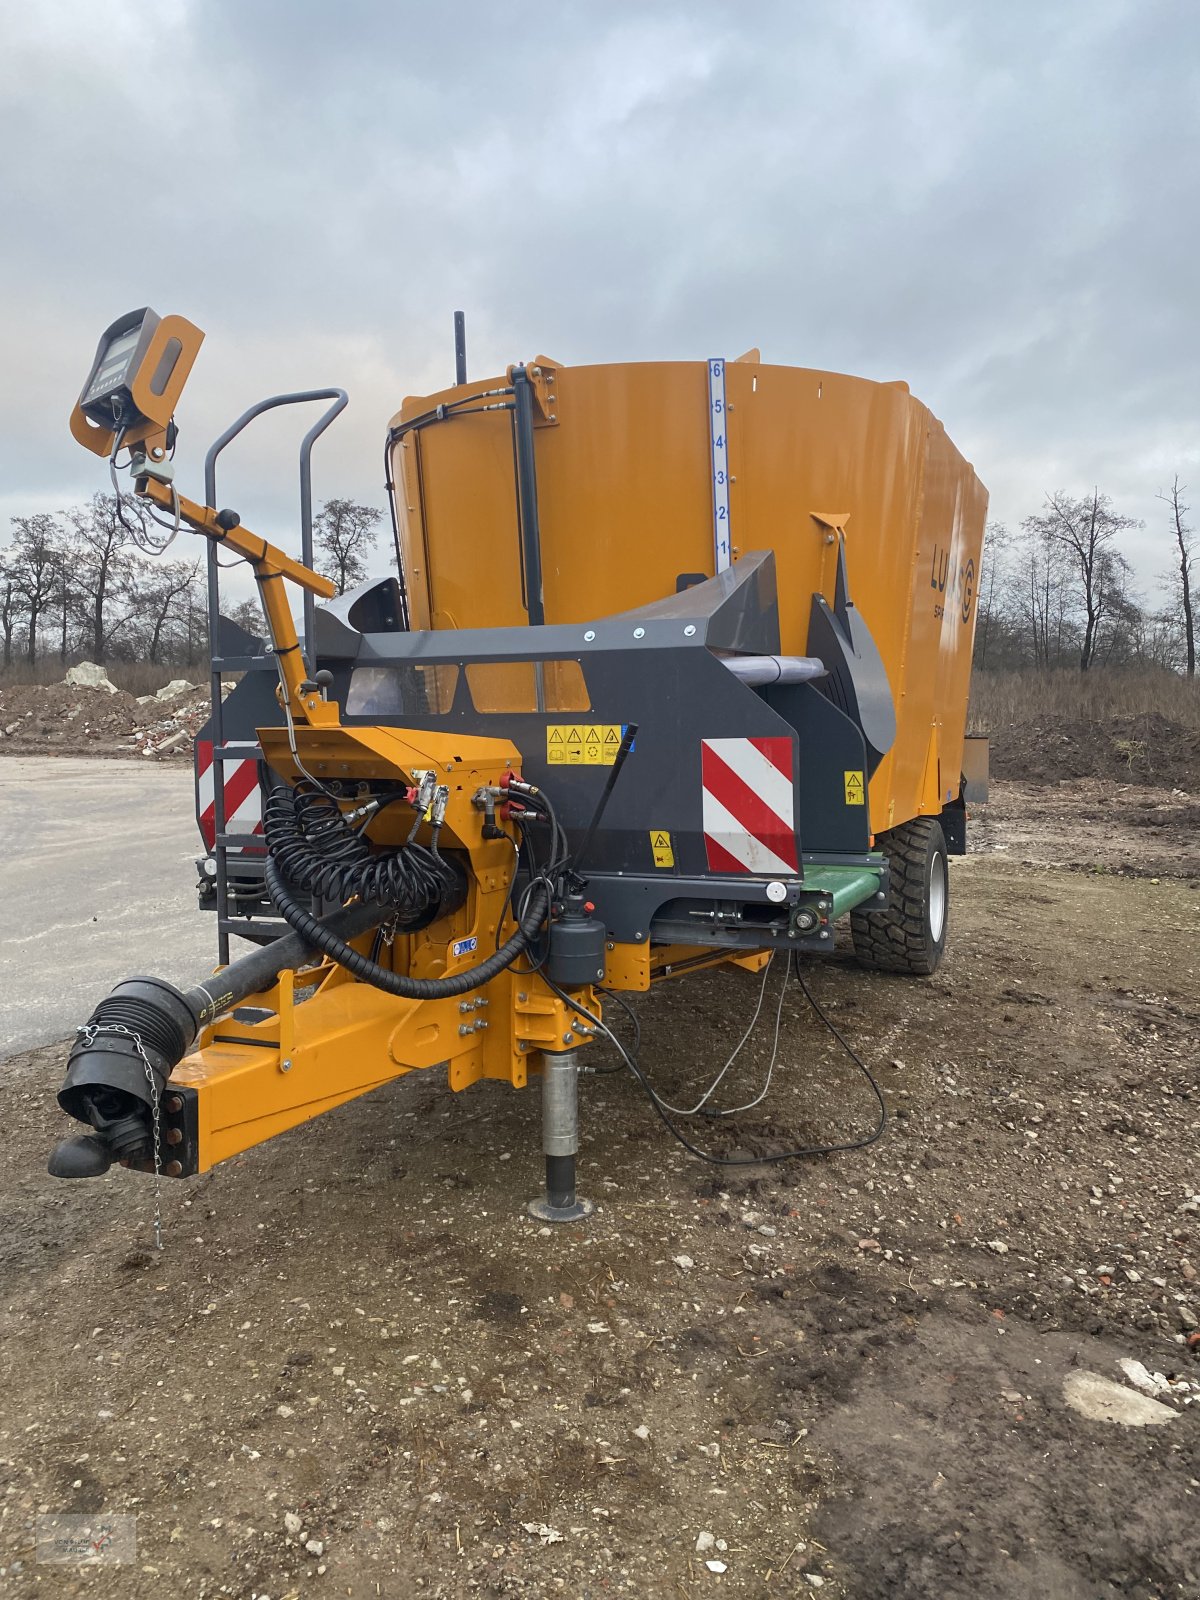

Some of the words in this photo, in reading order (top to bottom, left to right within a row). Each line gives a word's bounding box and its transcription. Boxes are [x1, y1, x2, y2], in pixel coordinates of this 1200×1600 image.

[713, 363, 721, 377] 6
[714, 399, 722, 413] 5
[715, 434, 724, 449] 4
[717, 470, 725, 484] 3
[718, 506, 726, 520] 2
[720, 541, 726, 554] 1
